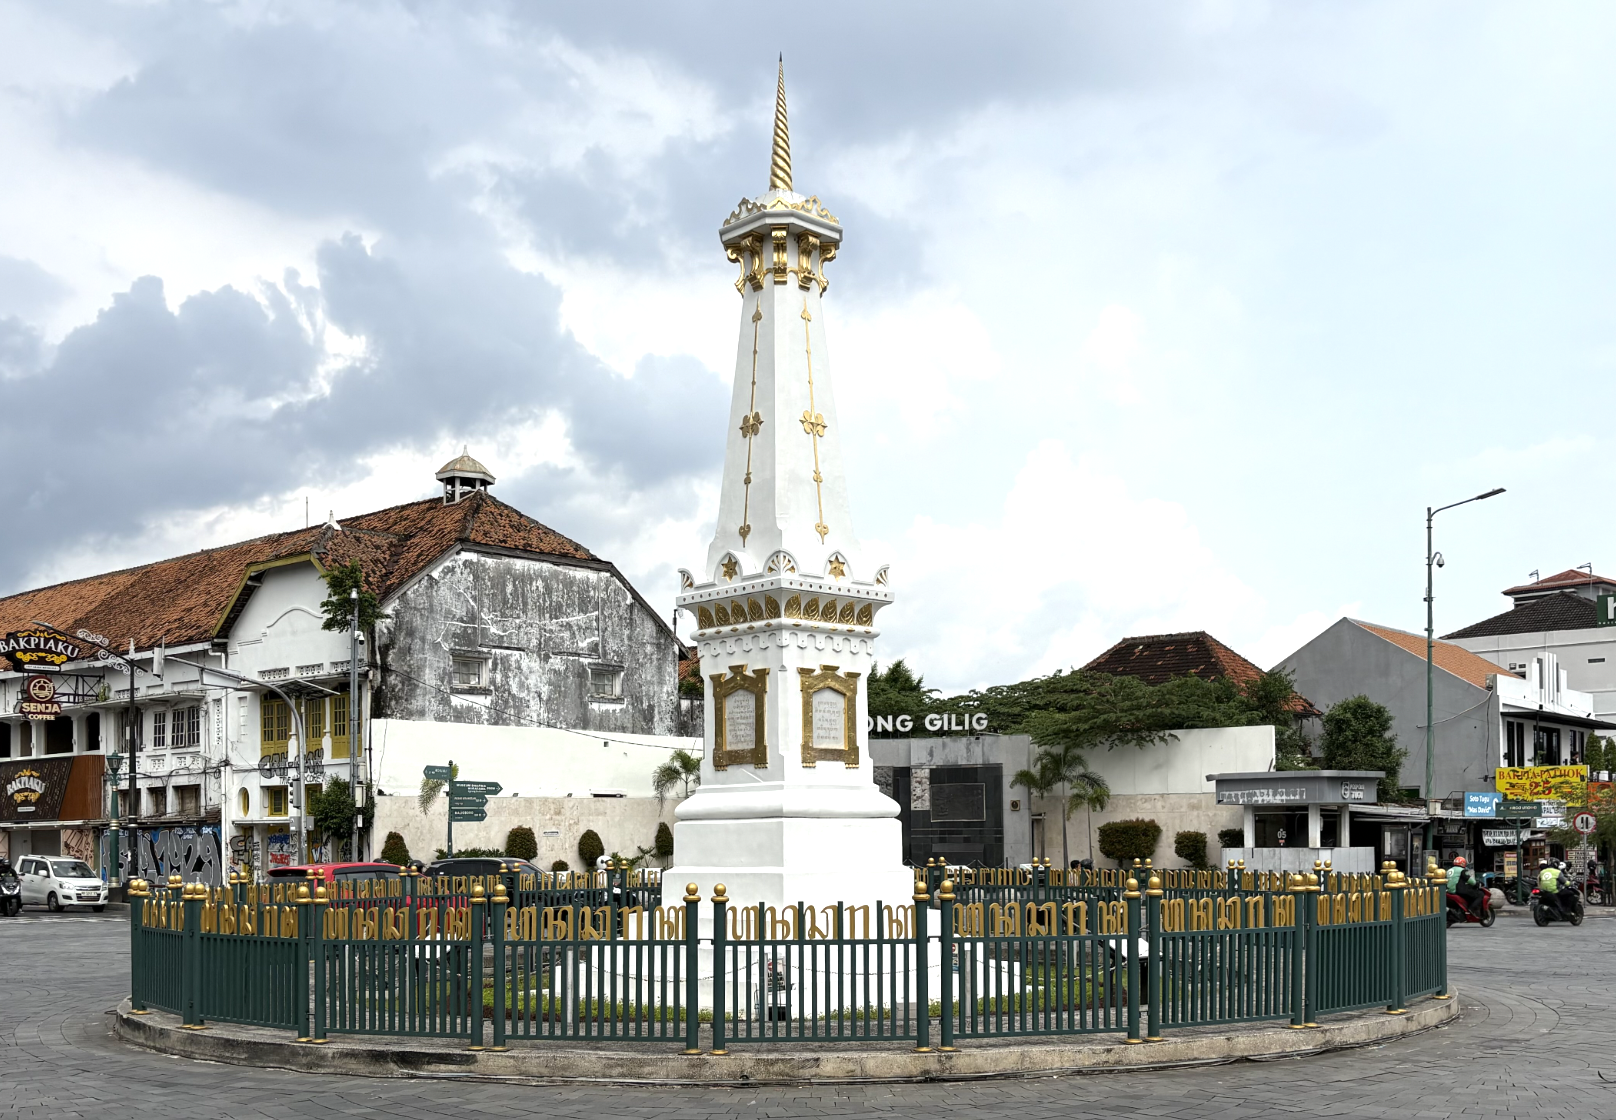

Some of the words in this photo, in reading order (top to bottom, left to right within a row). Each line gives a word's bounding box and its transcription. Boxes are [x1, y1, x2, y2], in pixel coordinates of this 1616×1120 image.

[0, 636, 79, 658] BAKPIAKU
[21, 702, 61, 713] SENJA
[924, 712, 989, 732] GILIG
[1479, 795, 1490, 804] Tugu
